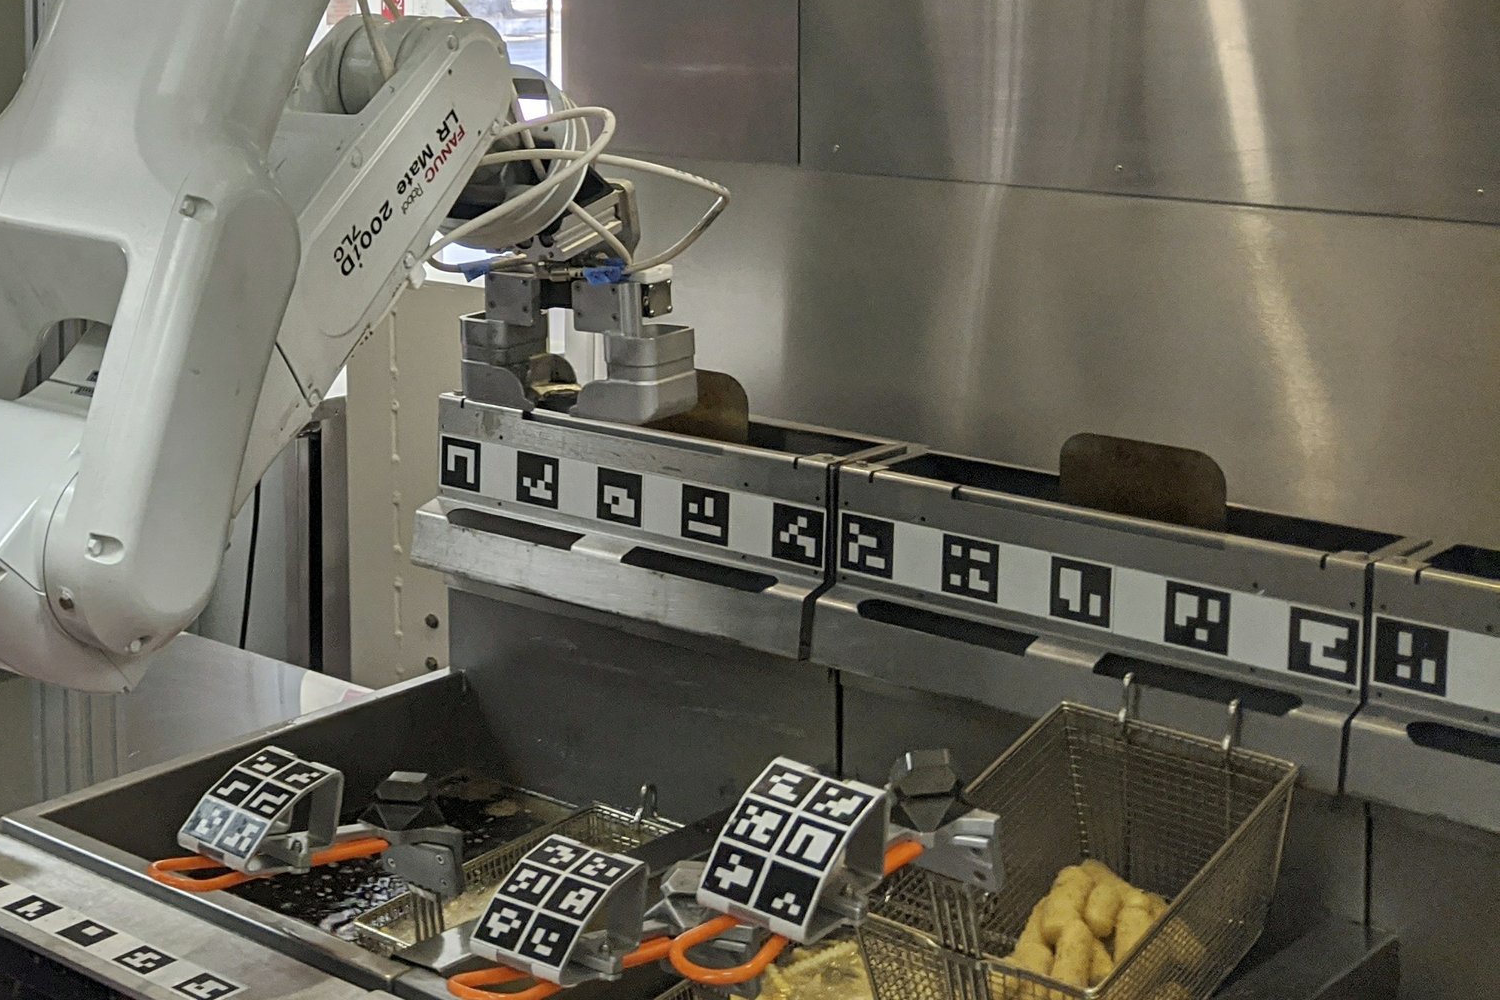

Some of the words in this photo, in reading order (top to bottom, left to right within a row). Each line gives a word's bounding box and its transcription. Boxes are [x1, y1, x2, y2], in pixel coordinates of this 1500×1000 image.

[436, 108, 460, 142] LR
[396, 143, 434, 195] Mate
[426, 124, 466, 183] FANUC
[333, 223, 363, 264] 7LC
[340, 199, 394, 277] 200iD
